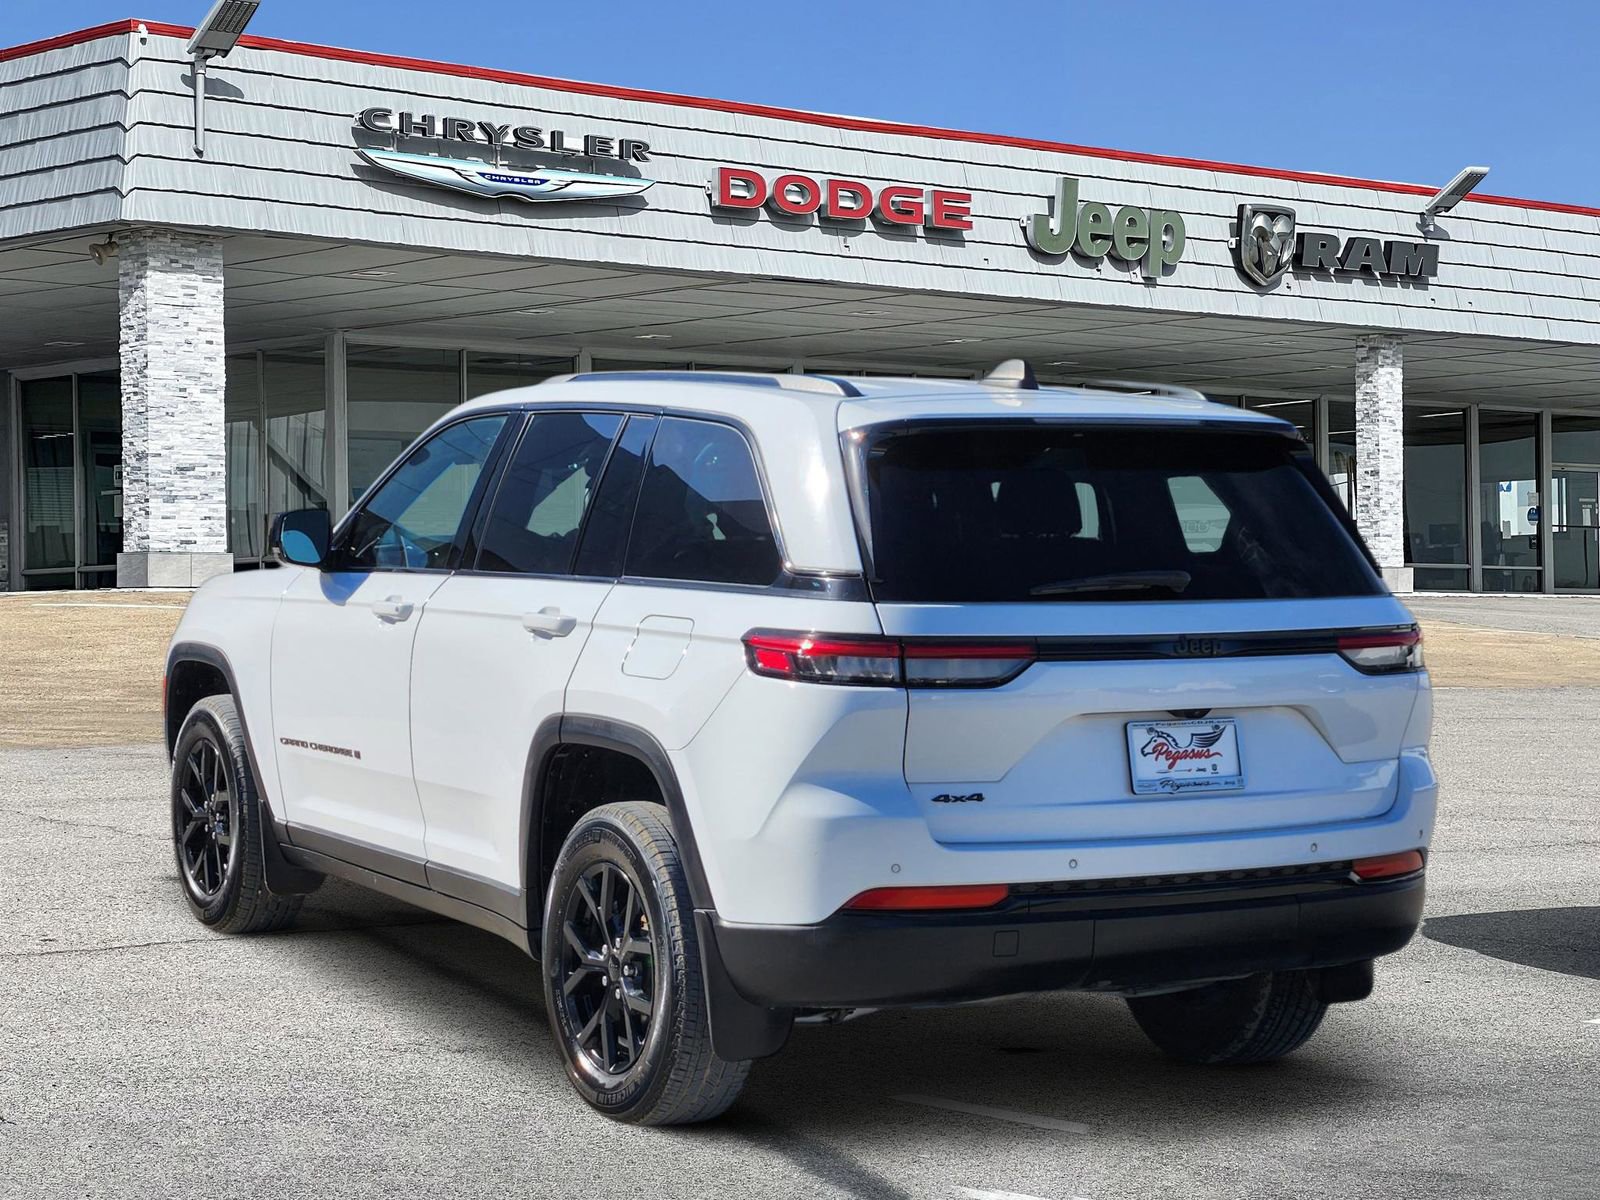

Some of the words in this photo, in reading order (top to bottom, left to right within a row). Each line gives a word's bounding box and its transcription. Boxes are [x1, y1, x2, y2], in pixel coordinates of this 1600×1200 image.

[358, 107, 652, 162] CHRYSLER
[484, 174, 541, 185] CHRYSLER
[712, 166, 973, 231] DODGE
[1027, 177, 1186, 278] Jeep
[1292, 232, 1440, 278] RAM
[1152, 742, 1223, 770] Pegasus
